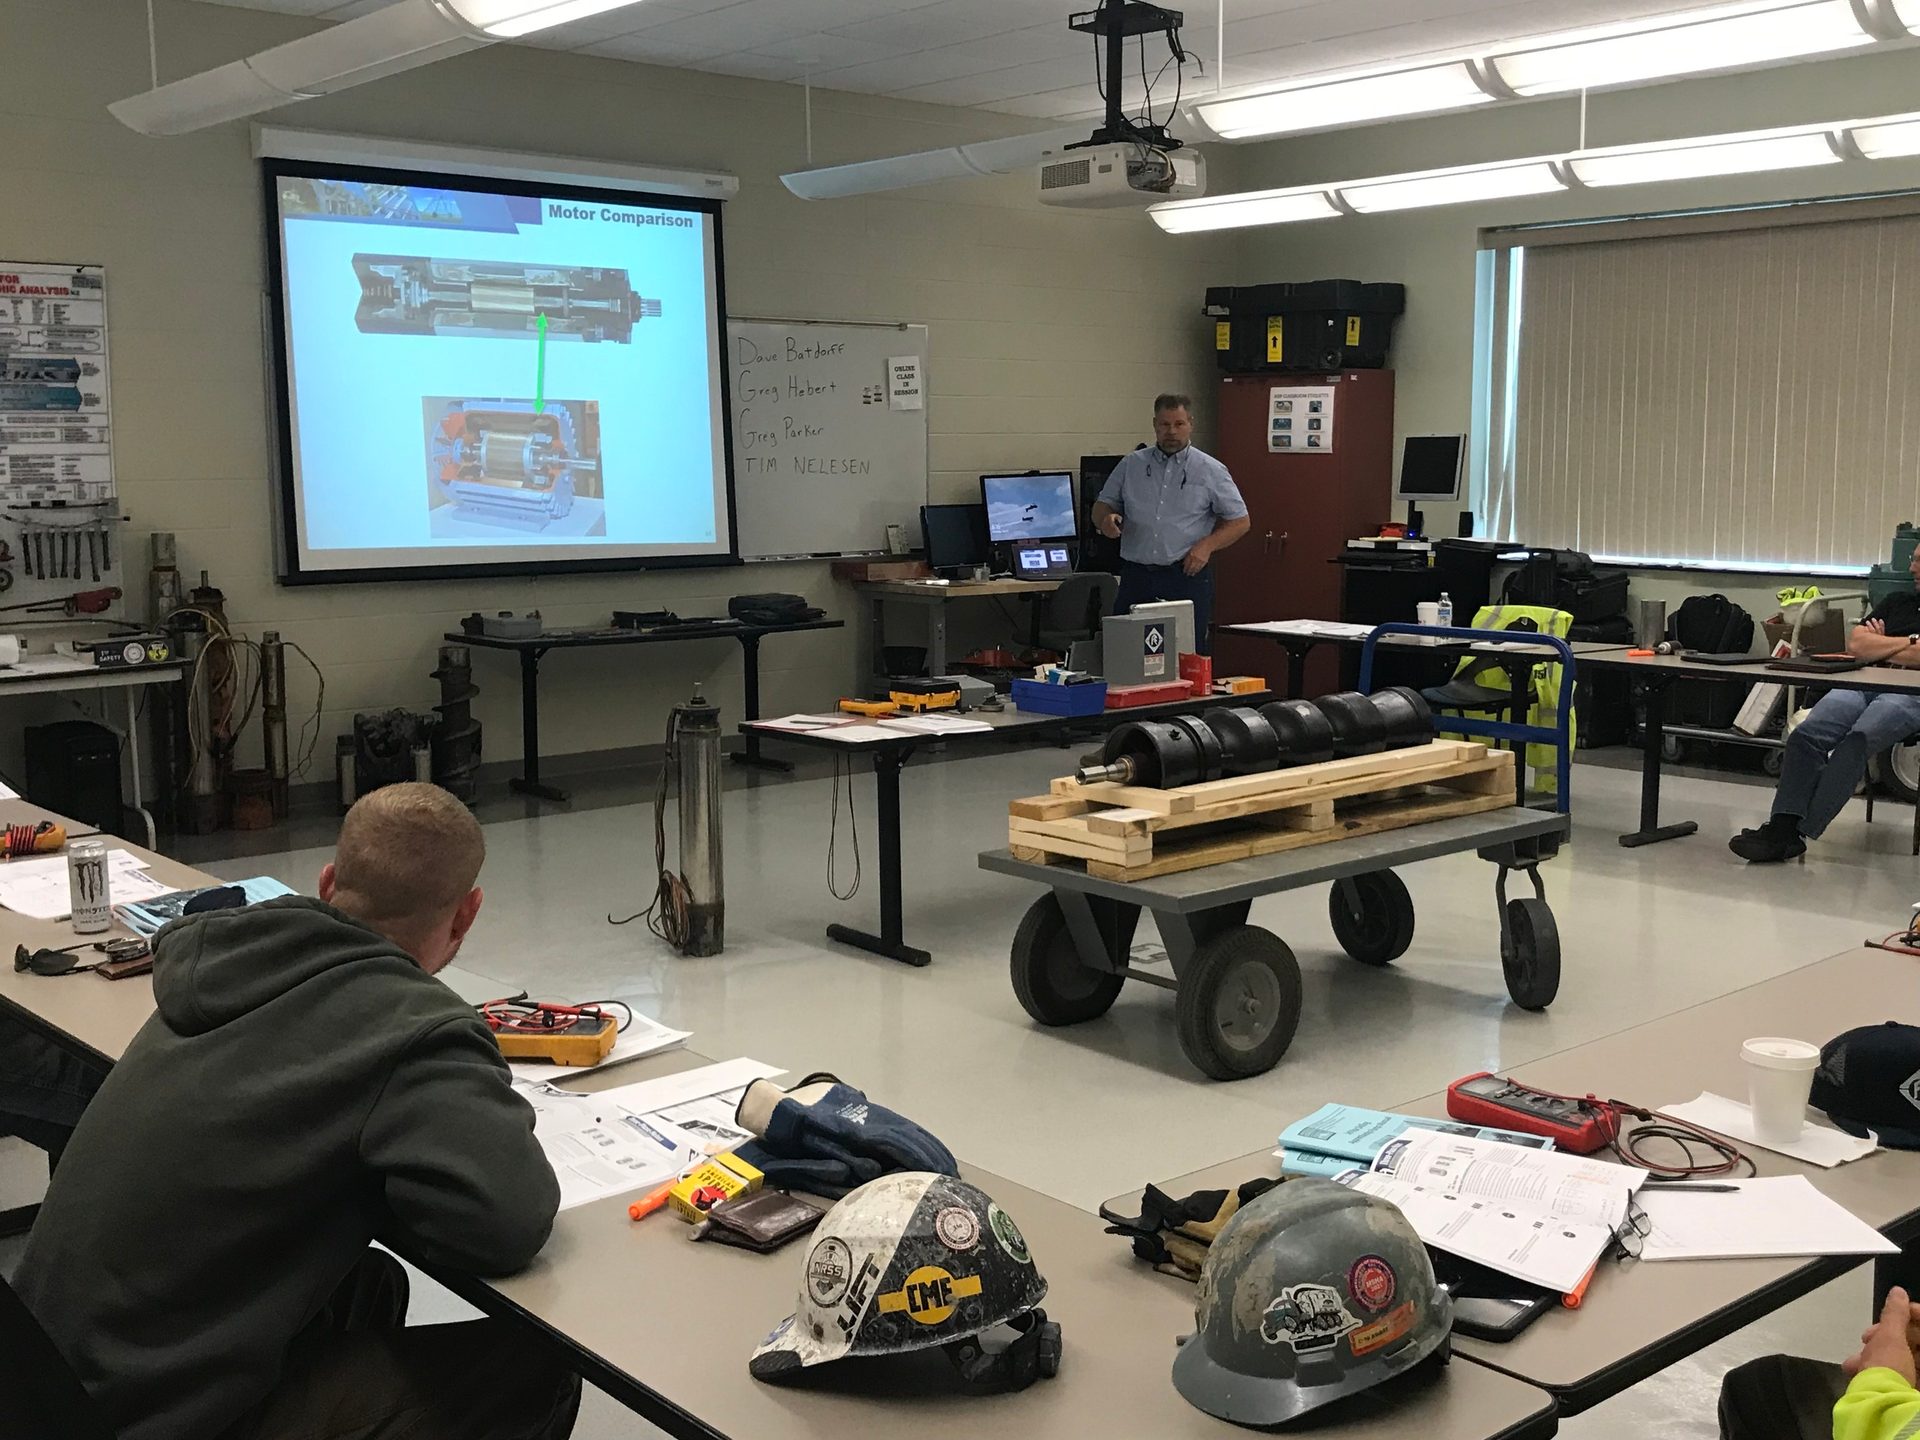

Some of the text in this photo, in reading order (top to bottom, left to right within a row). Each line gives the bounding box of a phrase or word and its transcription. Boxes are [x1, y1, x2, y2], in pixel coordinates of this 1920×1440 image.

[549, 204, 694, 228] Motor Comparison
[19, 286, 69, 296] ANALYSIS
[738, 336, 846, 366] Dave Batdorff
[738, 369, 838, 404] Greg Hebert
[739, 407, 825, 449] Greg Parker
[745, 456, 871, 475] TIM NELESEN
[697, 1171, 731, 1196] SPIRIT
